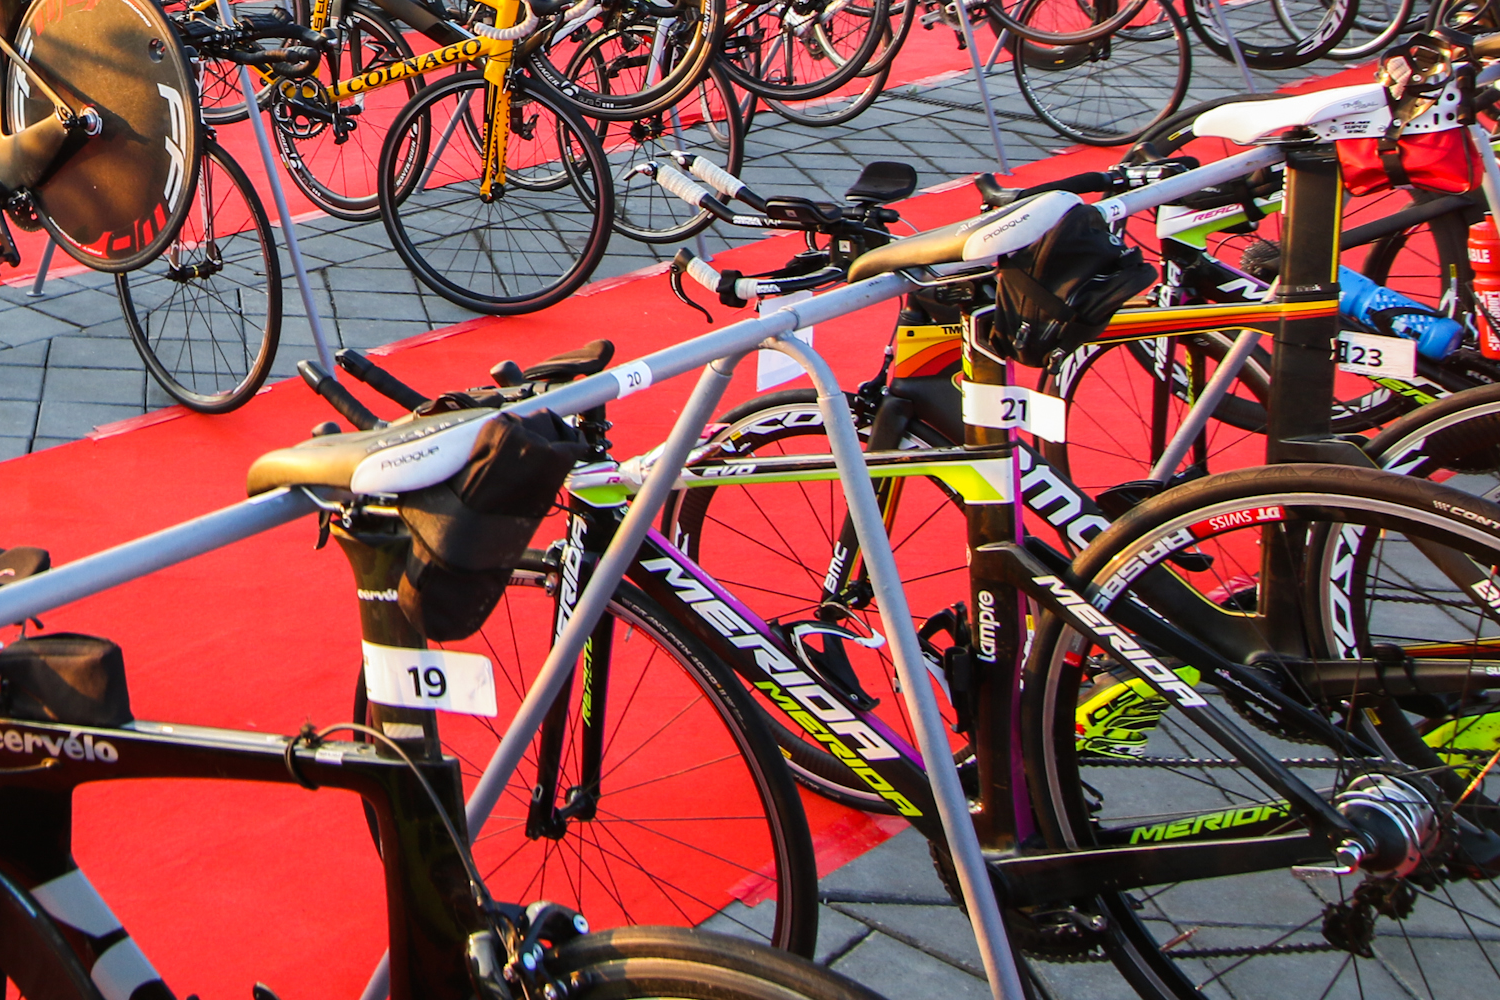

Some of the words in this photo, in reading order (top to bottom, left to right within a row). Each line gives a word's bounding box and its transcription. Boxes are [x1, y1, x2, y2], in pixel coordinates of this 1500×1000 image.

[346, 40, 482, 95] COLNAGO
[1110, 204, 1121, 217] 22
[983, 213, 1031, 243] Prologue
[1350, 345, 1384, 368] 23
[626, 371, 643, 389] 20
[1000, 397, 1028, 423] 21
[380, 445, 441, 472] Prologue
[702, 463, 757, 477] EVO
[1208, 510, 1254, 530] SWISS
[1256, 505, 1282, 521] DT
[555, 515, 589, 646] ERIDA
[822, 541, 849, 595] BMC
[357, 588, 399, 602] cervél
[1034, 574, 1209, 709] MERIDA
[639, 556, 901, 761] MERIDA
[406, 666, 449, 699] 19
[753, 681, 924, 818] MERIDA
[1129, 800, 1291, 846] MERIDA
